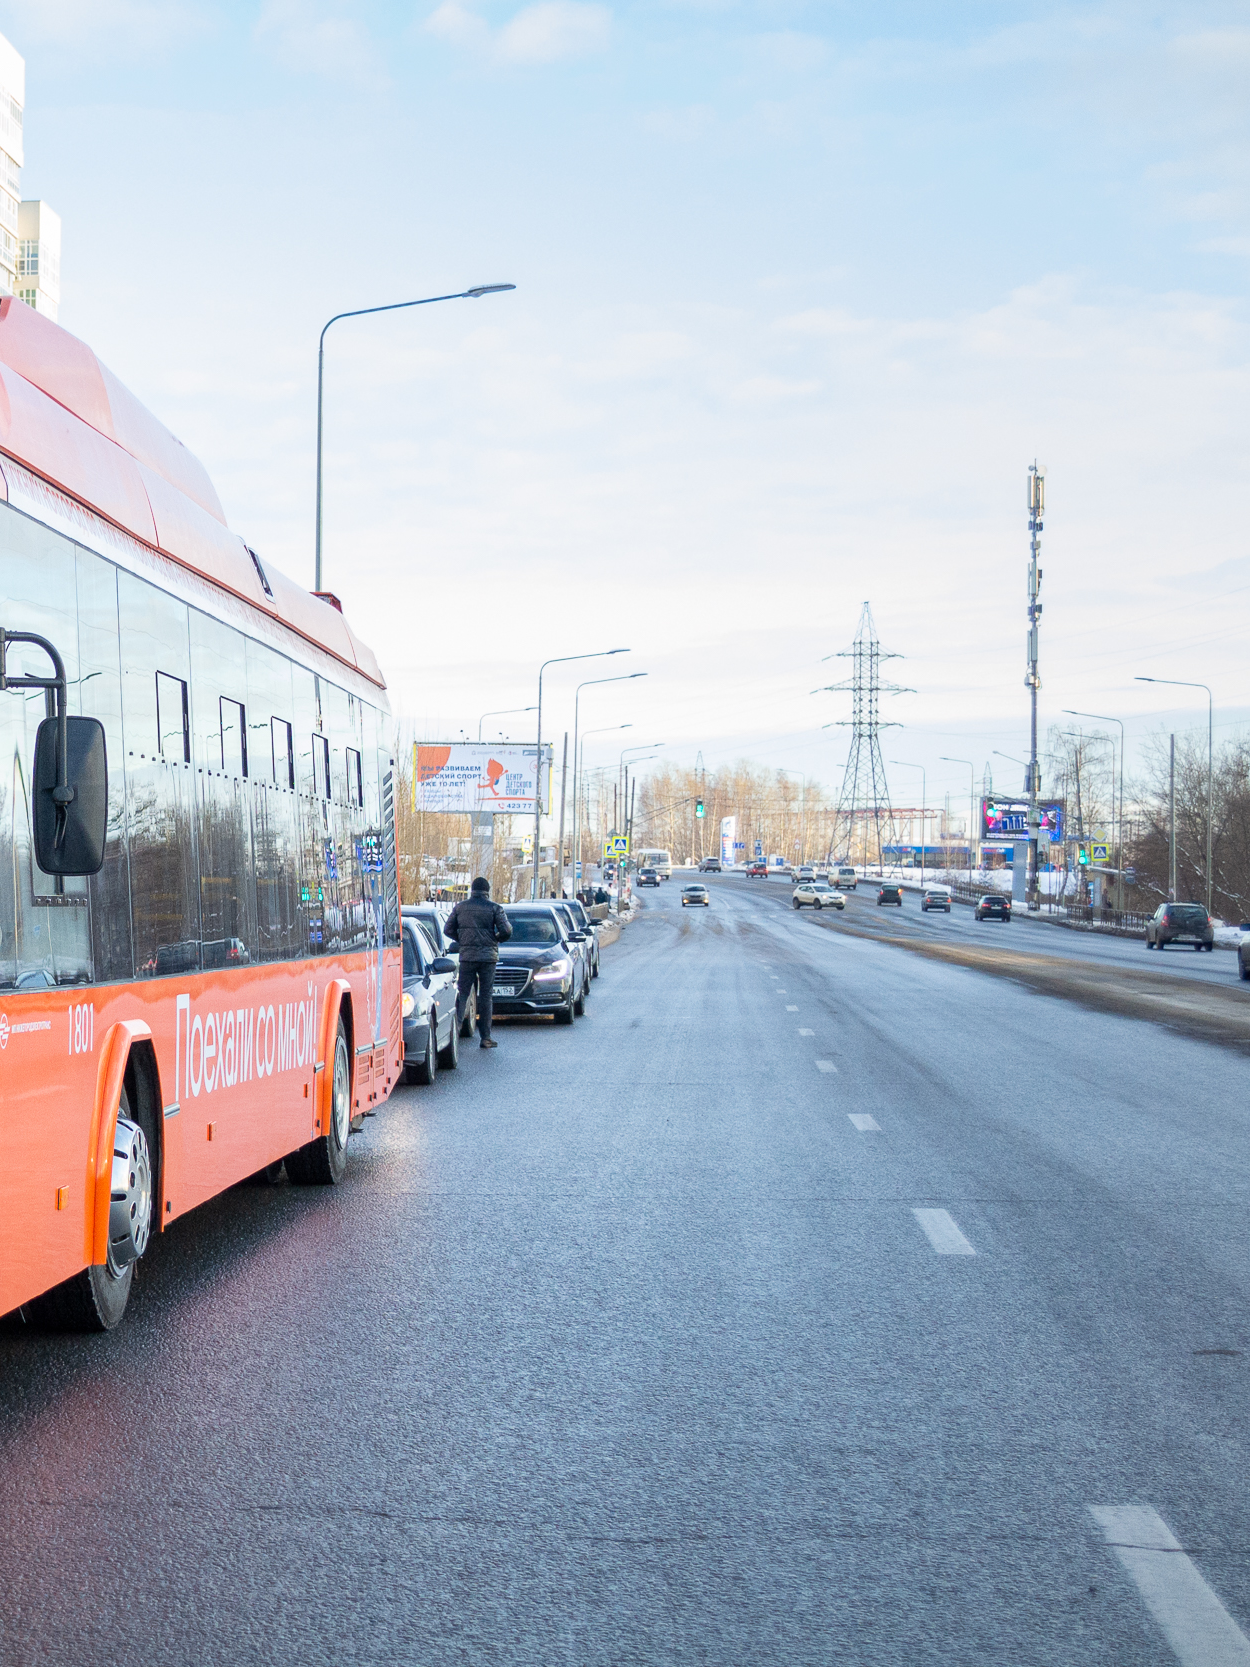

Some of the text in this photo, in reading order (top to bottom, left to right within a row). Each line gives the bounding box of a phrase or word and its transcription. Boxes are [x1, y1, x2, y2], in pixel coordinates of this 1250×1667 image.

[420, 772, 455, 780] ДЕТСКИЙ
[505, 773, 523, 781] ЦЕНТР
[505, 781, 532, 789] ДЕТСКОГО
[505, 788, 526, 796] СПОРТА
[68, 1002, 94, 1056] 1801
[175, 993, 254, 1102] Поехали
[255, 1004, 276, 1079] со
[277, 980, 318, 1073] мной!
